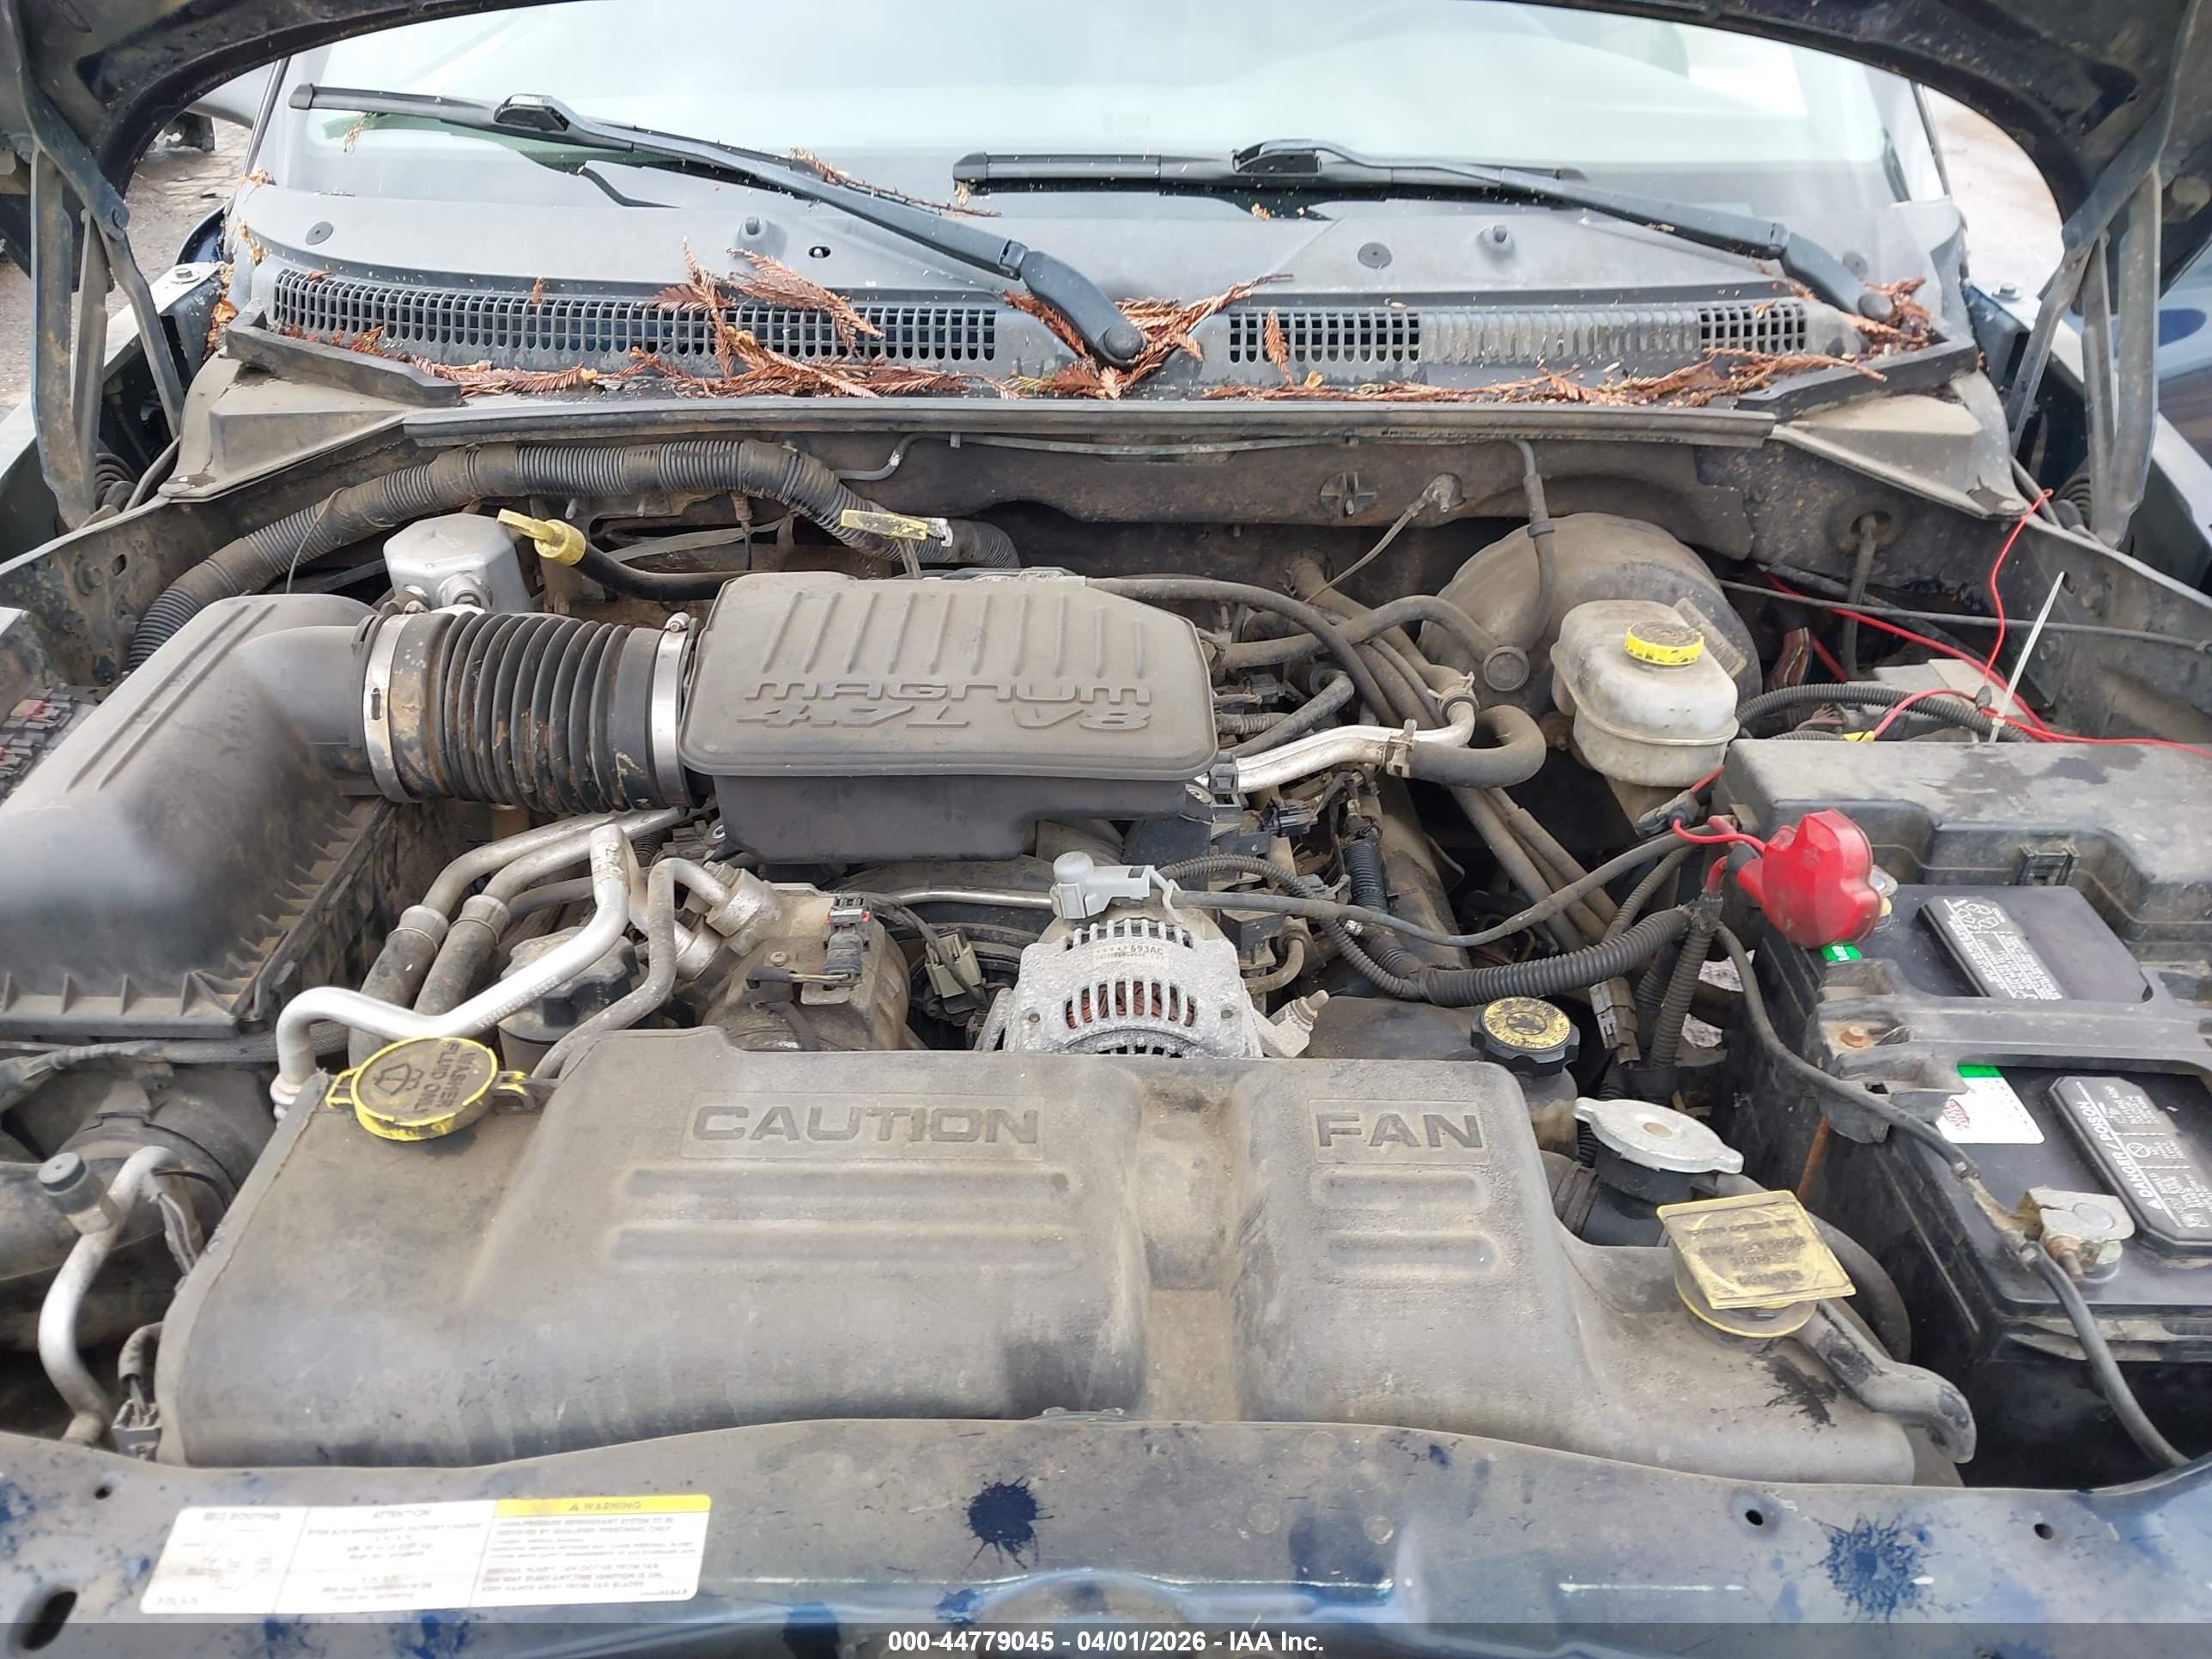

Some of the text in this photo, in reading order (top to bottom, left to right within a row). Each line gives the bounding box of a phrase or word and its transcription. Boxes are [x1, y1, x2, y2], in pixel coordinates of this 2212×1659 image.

[744, 681, 1152, 706] MAGNUM
[736, 703, 1152, 732] 4.7L V8
[413, 1042, 463, 1115] FLUID ONLY
[438, 1052, 477, 1108] WASHER
[691, 1105, 1485, 1151] CAUTION FAN
[2076, 1100, 2114, 1141] POISON
[2112, 1151, 2154, 1198] DANGER
[372, 1509, 432, 1519] ATTENTION
[583, 1501, 641, 1511] WARNING
